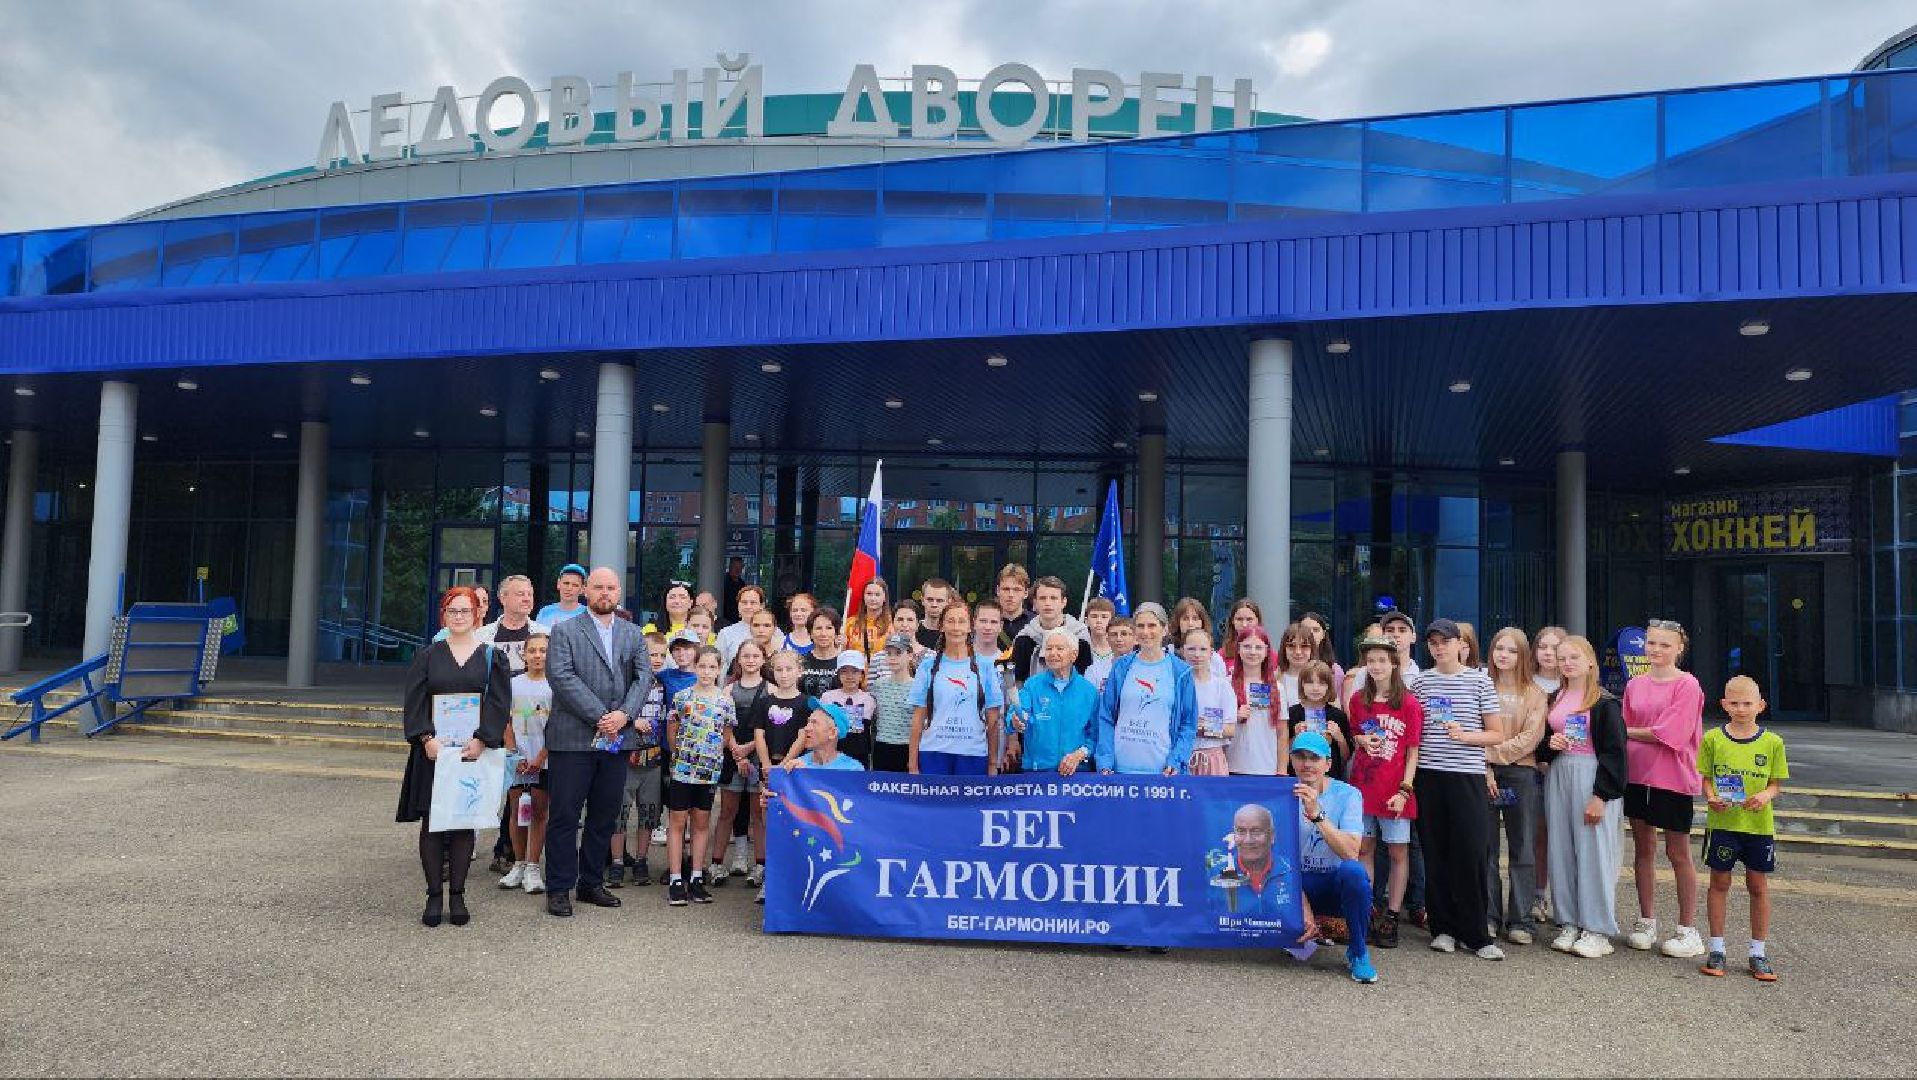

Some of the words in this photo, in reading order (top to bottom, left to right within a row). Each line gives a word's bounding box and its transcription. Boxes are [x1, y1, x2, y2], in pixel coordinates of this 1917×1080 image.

[316, 52, 765, 170] ЛЕДОВЫЙ
[1671, 508, 1816, 551] ХОККЕЙ
[868, 781, 959, 796] ФАКЕЛЬНАЯ
[964, 784, 1043, 797] ЭСТАФЕТА
[1047, 784, 1058, 798] В
[1062, 784, 1124, 798] РОССИИ
[1128, 785, 1140, 799] С
[1144, 785, 1176, 798] 1991
[1179, 788, 1191, 800] г.
[979, 808, 1076, 848] БЕГ
[875, 857, 1184, 907] ГАРМОНИИ
[947, 914, 1110, 935] БЕГ-ГАРМОНИИ.РФ
